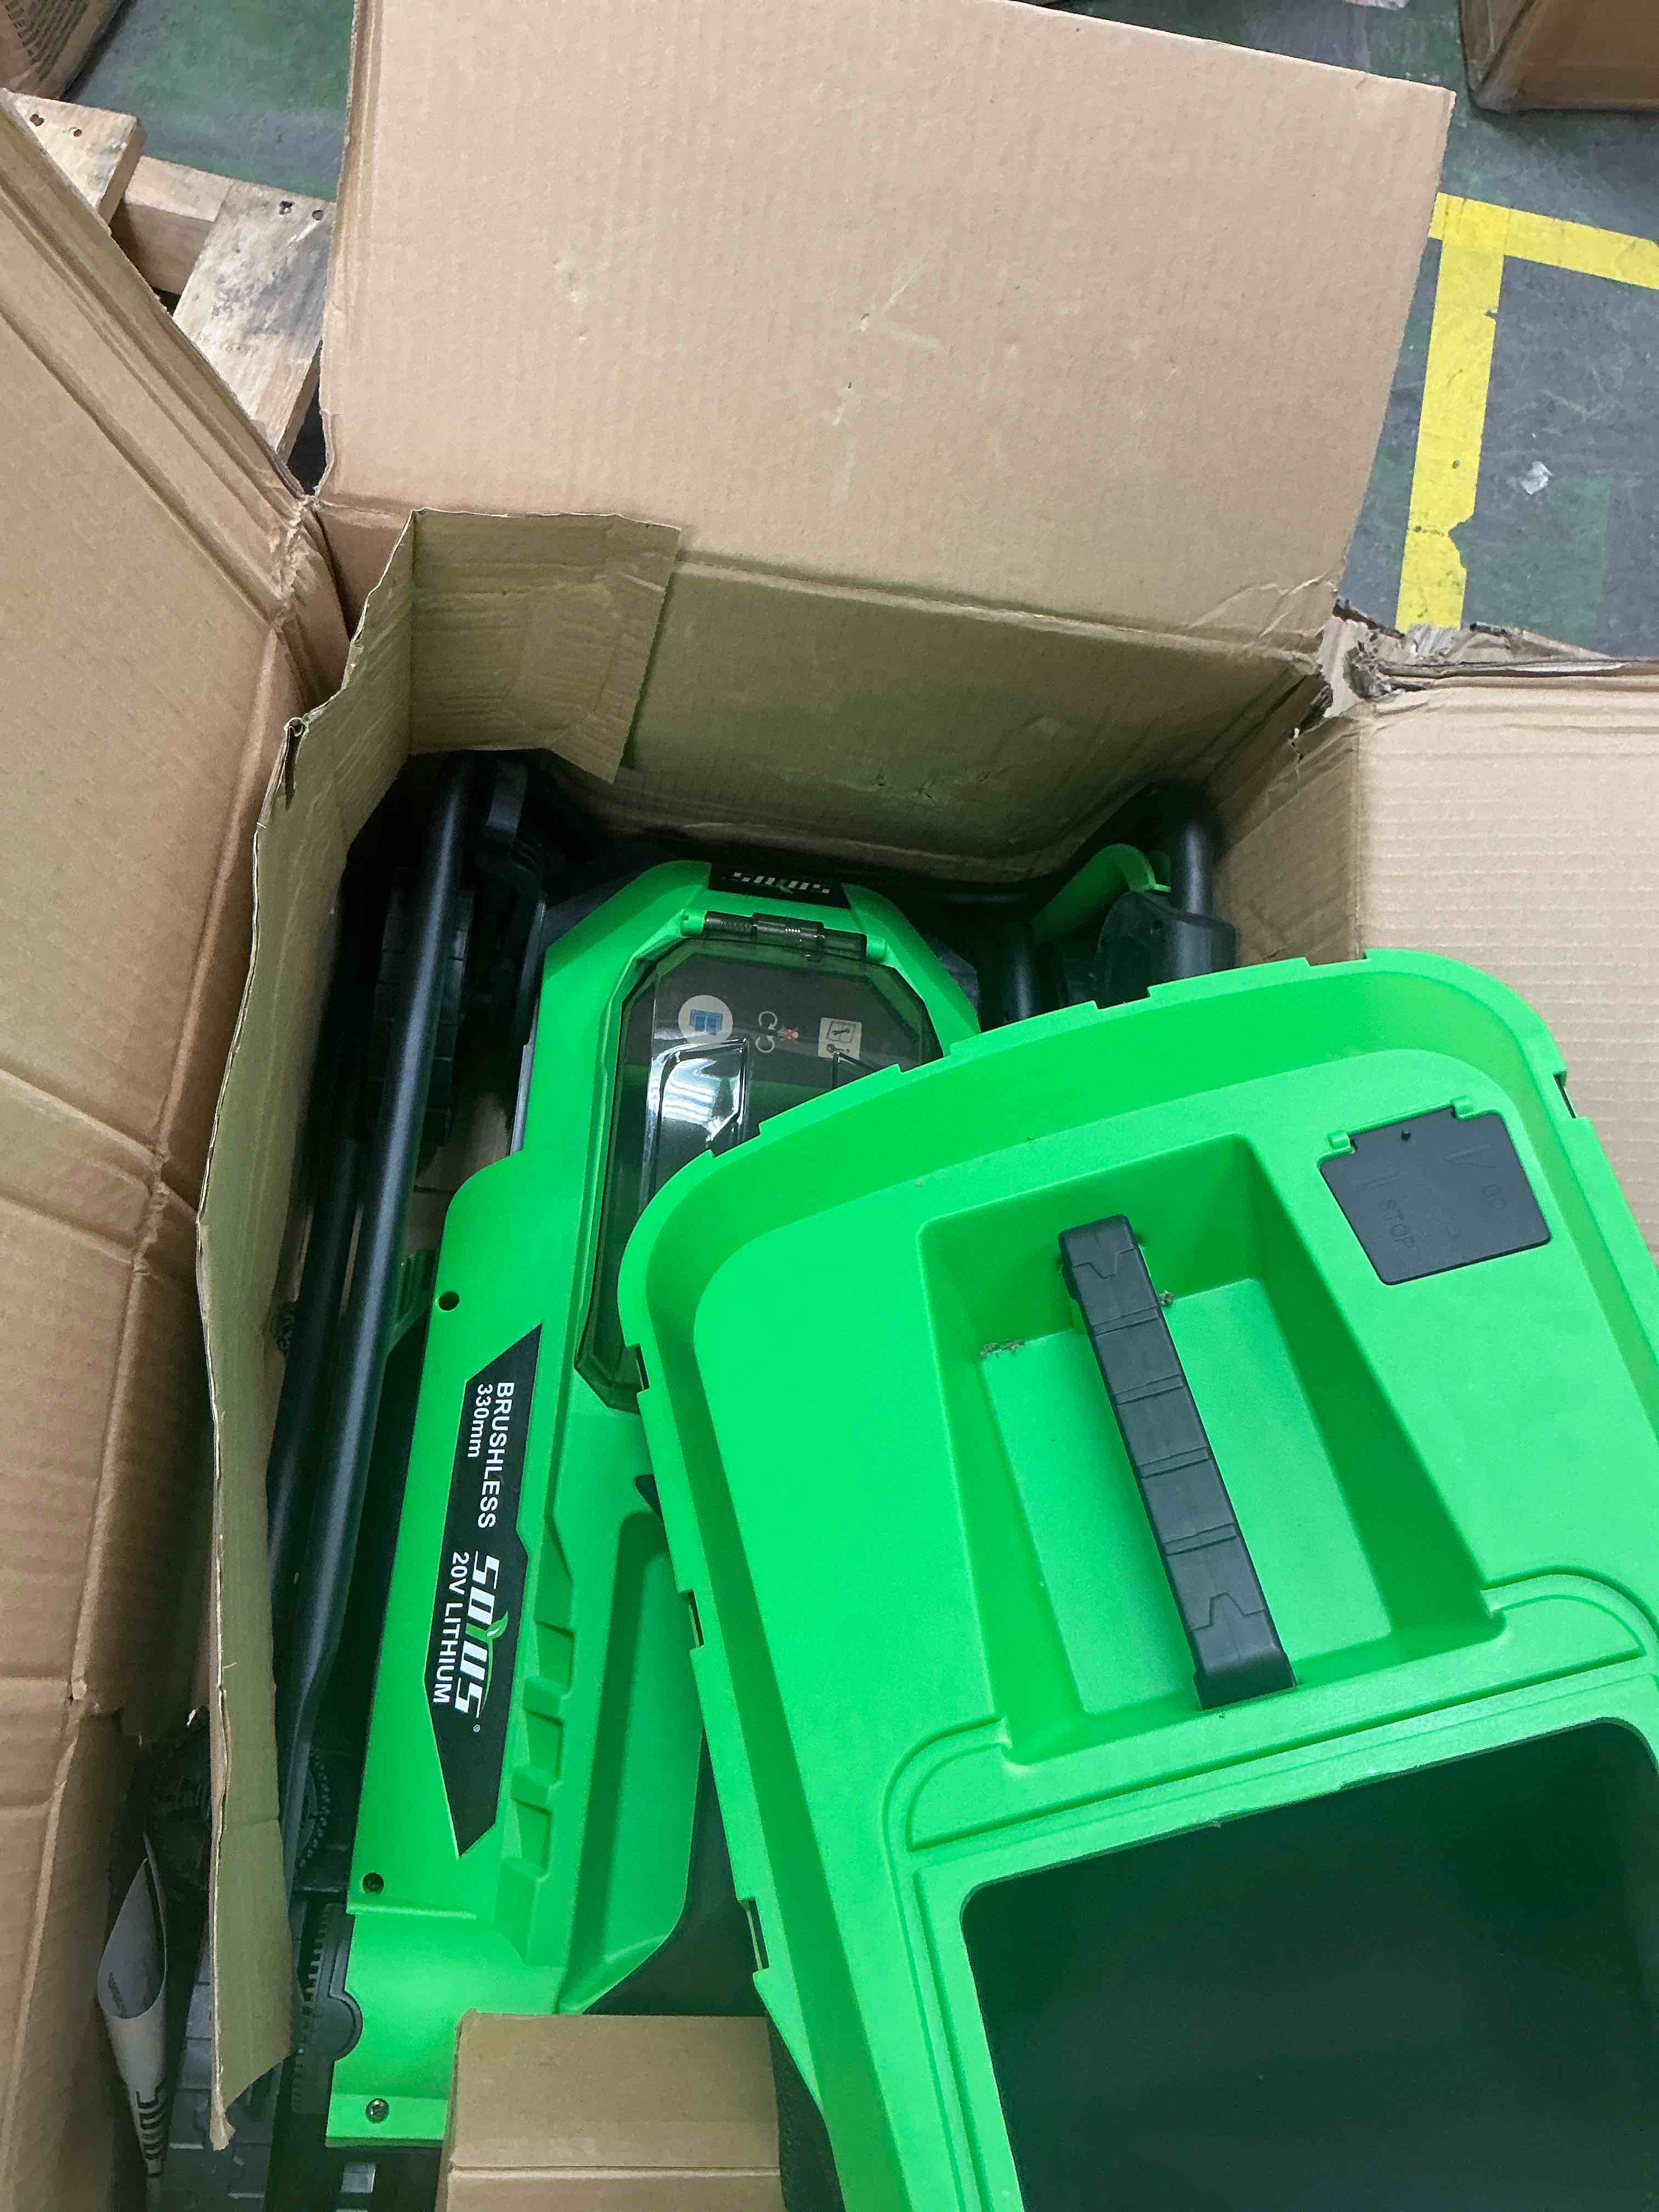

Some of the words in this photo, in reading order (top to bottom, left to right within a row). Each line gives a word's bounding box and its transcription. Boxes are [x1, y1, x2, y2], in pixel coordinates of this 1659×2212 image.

[467, 1383, 494, 1458] 330mm
[477, 1381, 516, 1529] BRUSHLESS
[448, 1551, 470, 1596] 20V
[432, 1602, 464, 1703] LITHIUM
[454, 1551, 509, 1719] SOYUS
